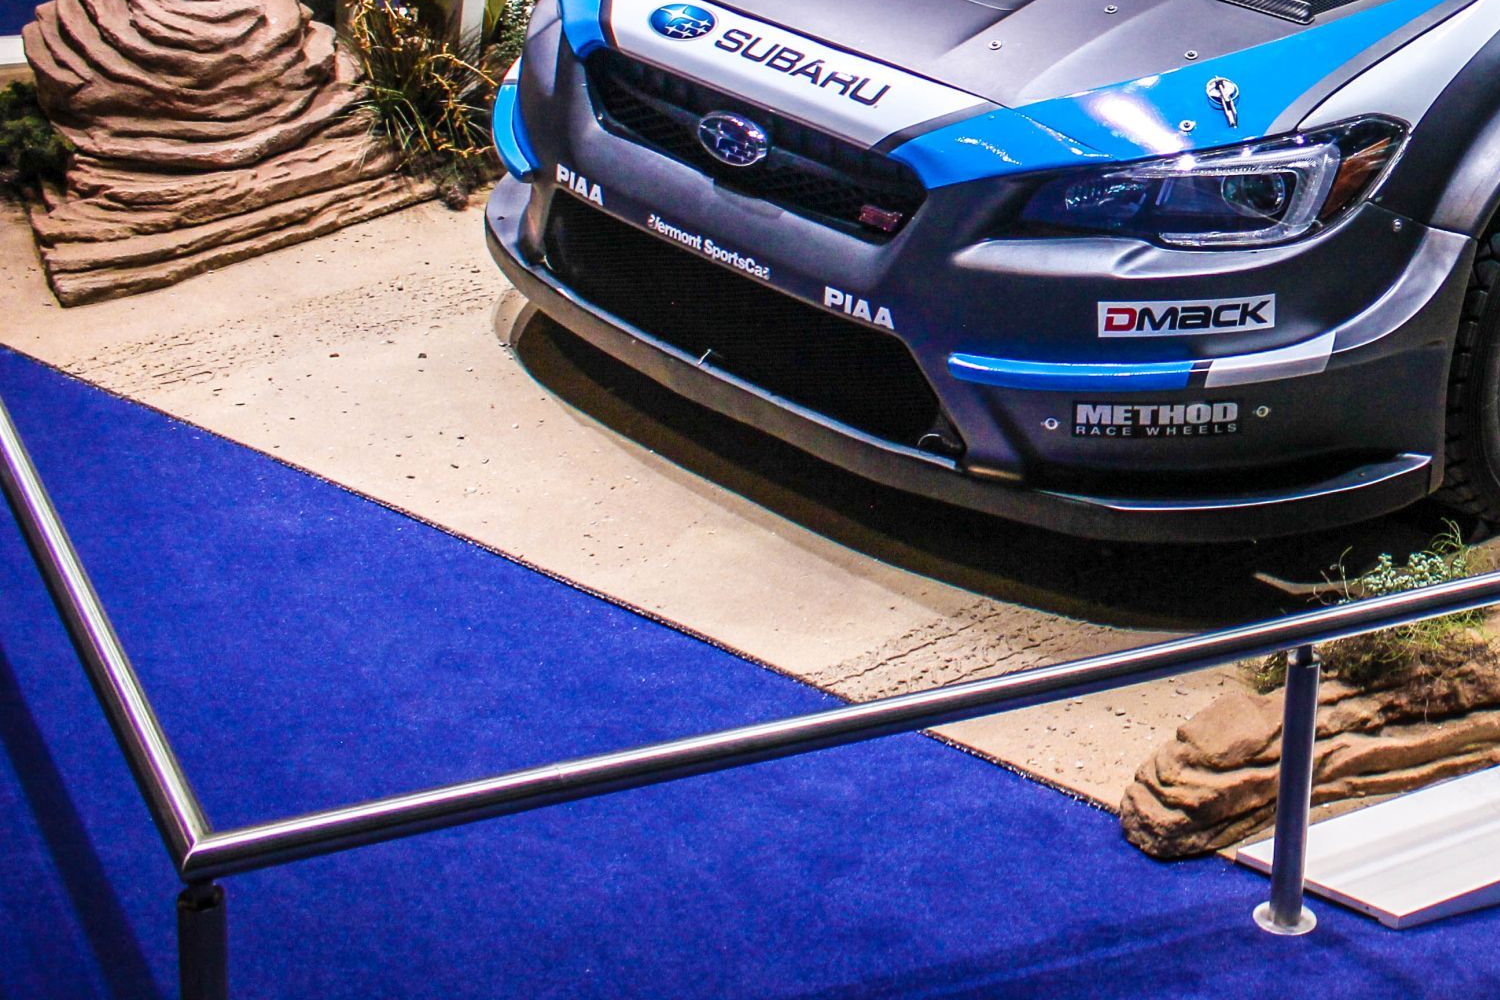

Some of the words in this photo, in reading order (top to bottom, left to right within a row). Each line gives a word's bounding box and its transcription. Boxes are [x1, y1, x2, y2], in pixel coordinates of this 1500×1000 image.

[714, 28, 892, 108] SUBARU
[556, 163, 604, 206] PIAA
[824, 286, 895, 330] PIAA
[1075, 402, 1238, 425] METHOD
[1075, 424, 1136, 435] RACE
[1146, 422, 1238, 435] WHEELS
